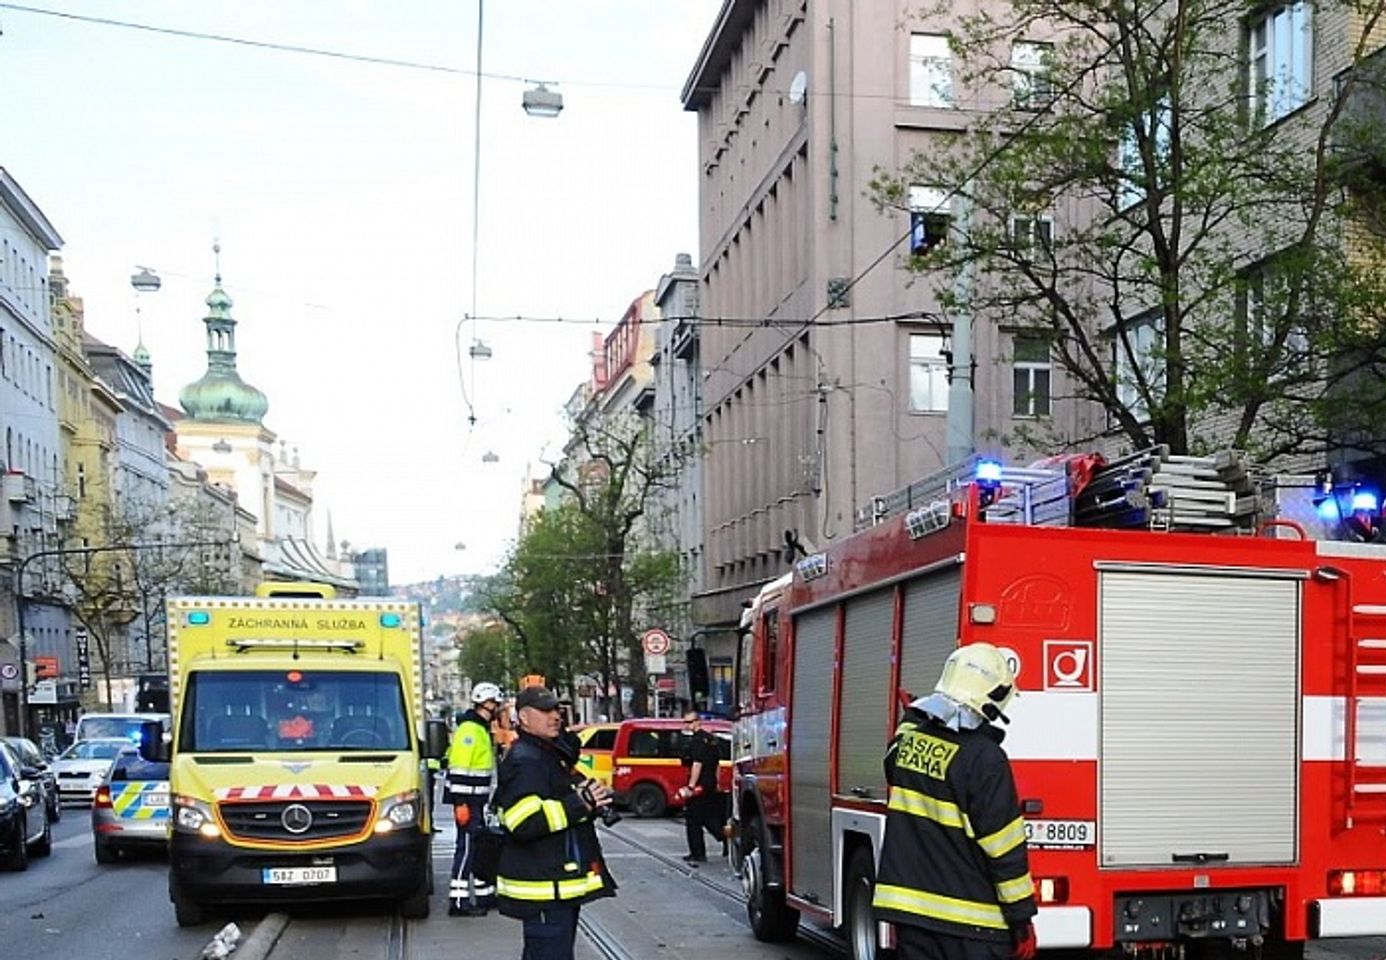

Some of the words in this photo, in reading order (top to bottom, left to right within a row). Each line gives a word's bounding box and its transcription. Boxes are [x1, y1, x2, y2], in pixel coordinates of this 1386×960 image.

[228, 617, 309, 630] ZÁCHRANNÁ
[316, 617, 366, 631] SLUŽBA
[898, 749, 942, 776] RAHA
[1046, 823, 1087, 841] 8809
